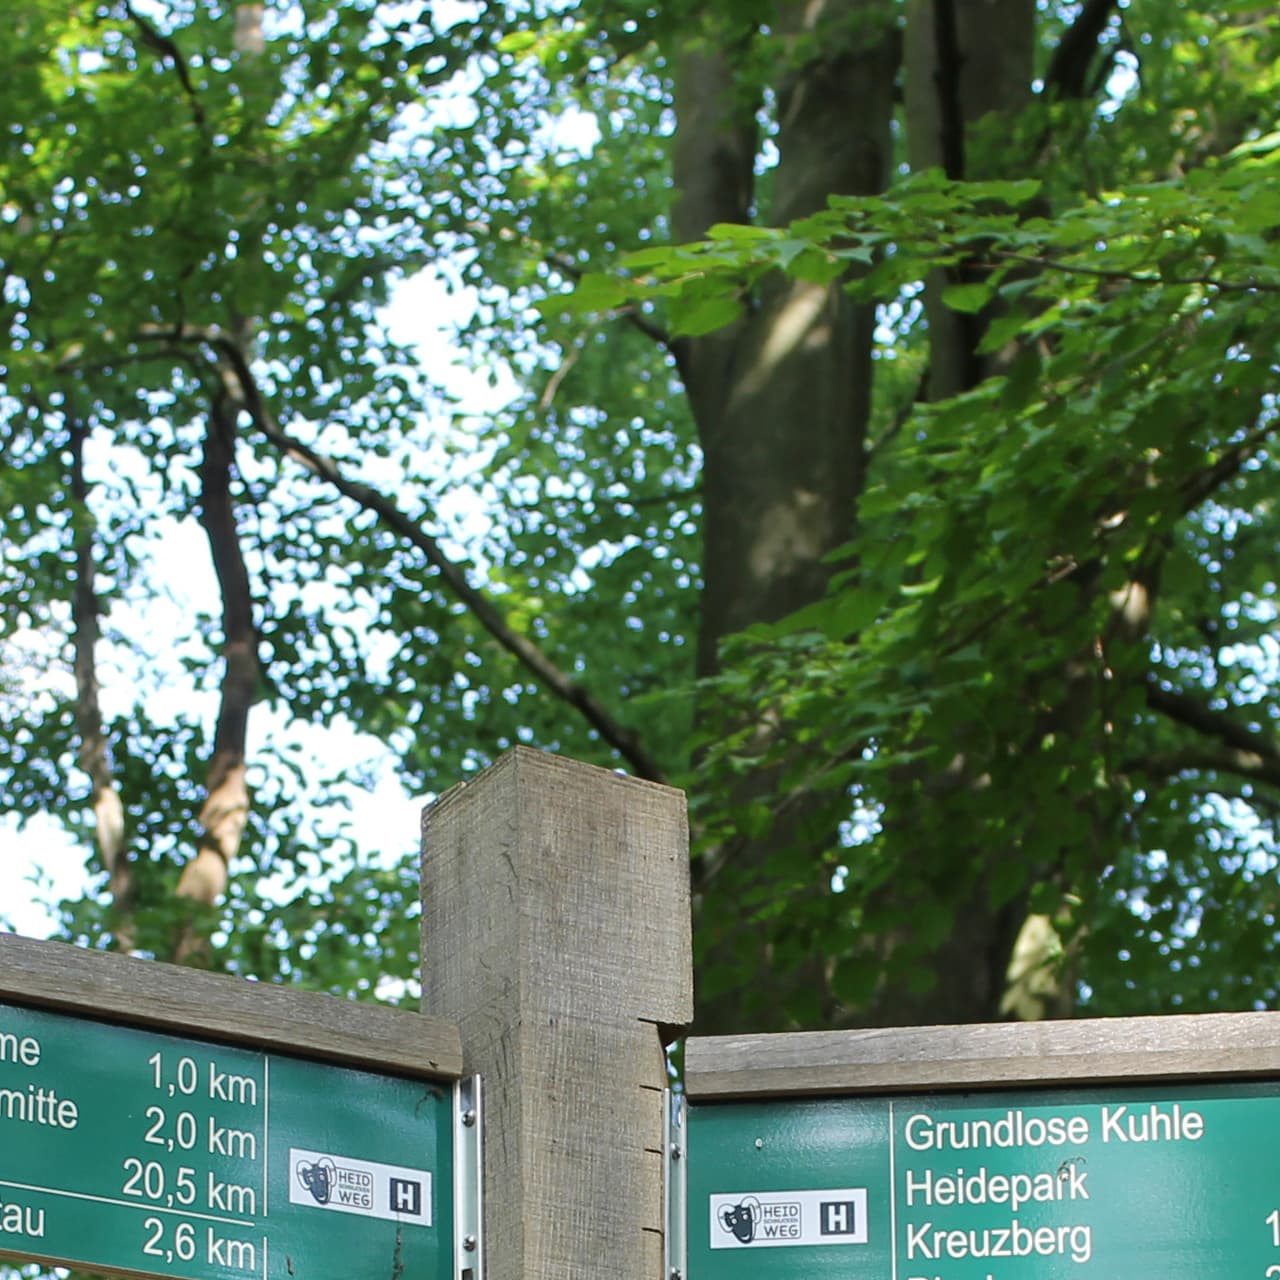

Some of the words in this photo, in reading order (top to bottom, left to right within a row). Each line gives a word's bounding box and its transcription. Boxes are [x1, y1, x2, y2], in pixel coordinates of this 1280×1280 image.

[148, 1052, 197, 1097] 1,0
[209, 1062, 257, 1106] km
[145, 1106, 197, 1152] 2,0
[208, 1116, 256, 1160] km
[905, 1111, 1089, 1150] Grundlose
[1101, 1104, 1204, 1143] Kuhle
[122, 1158, 196, 1207] 20,5
[208, 1172, 256, 1215] km
[338, 1170, 370, 1187] HEID
[338, 1190, 370, 1207] WEG
[396, 1182, 414, 1211] H
[906, 1164, 1090, 1212] Heidepark
[763, 1205, 799, 1218] HEID
[763, 1224, 799, 1237] WEG
[828, 1205, 847, 1231] H
[143, 1217, 196, 1263] 2,6
[207, 1227, 255, 1270] km
[906, 1219, 1092, 1263] Kreuzberg
